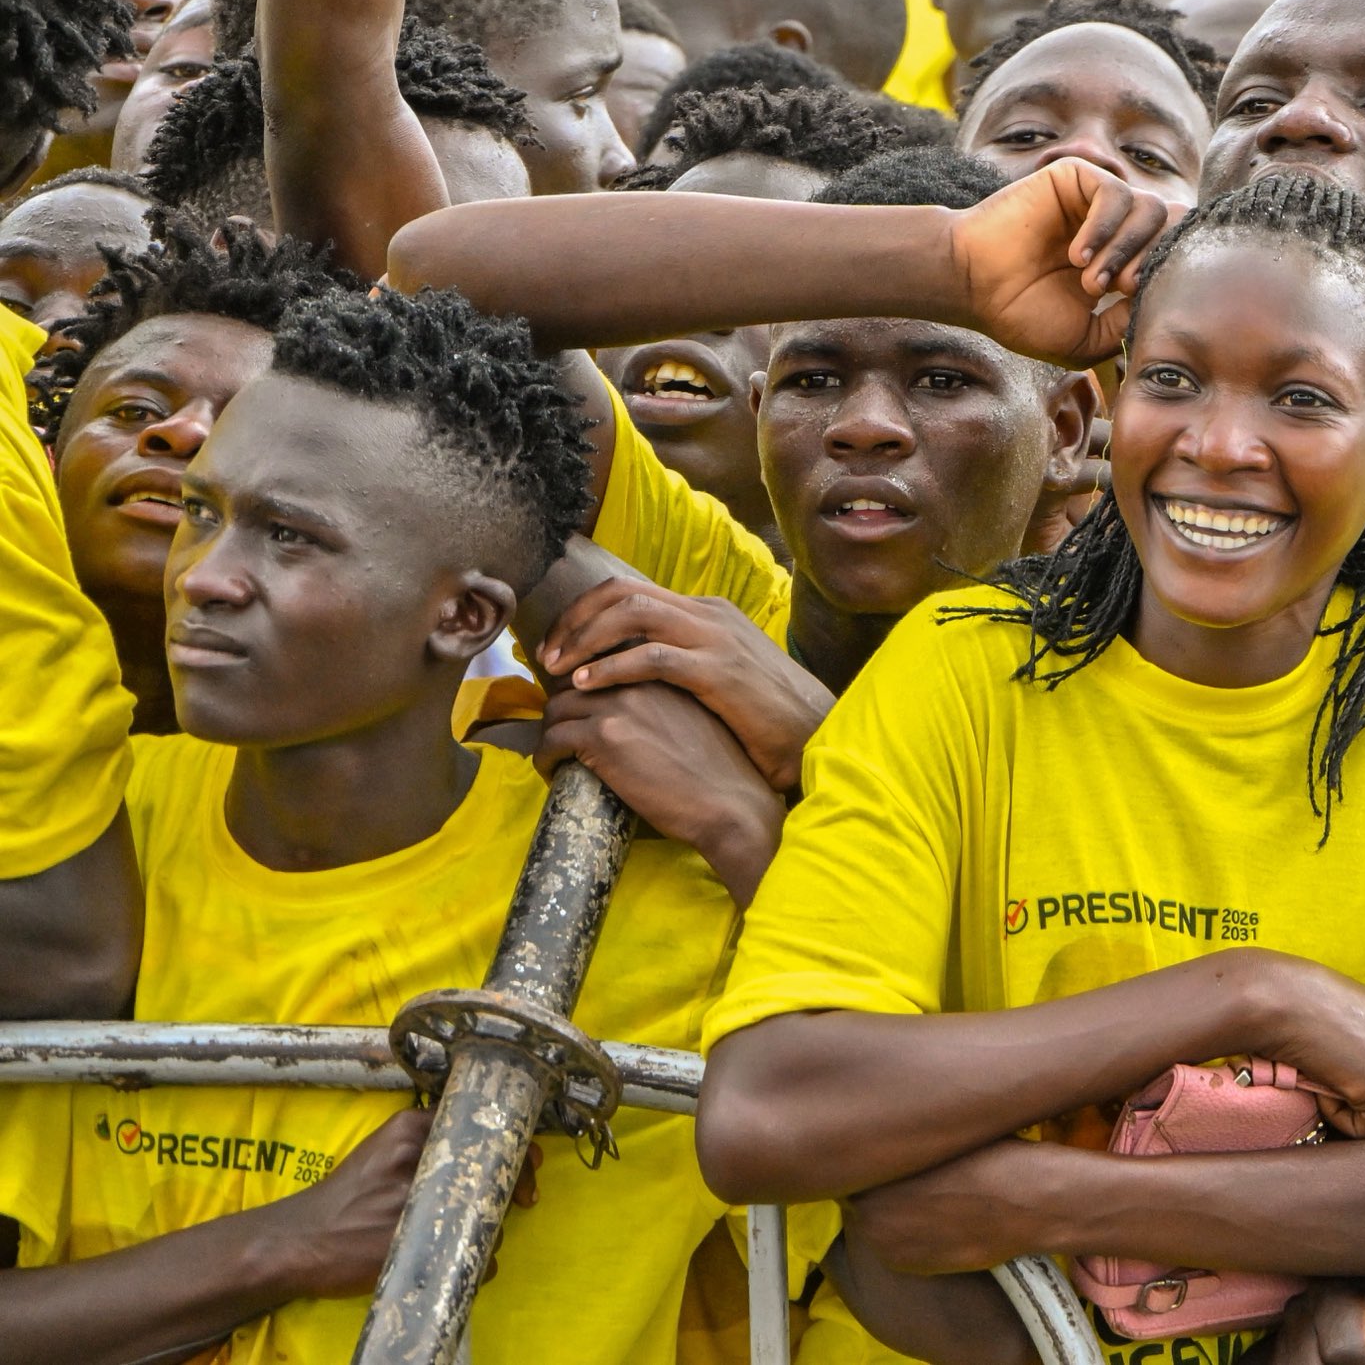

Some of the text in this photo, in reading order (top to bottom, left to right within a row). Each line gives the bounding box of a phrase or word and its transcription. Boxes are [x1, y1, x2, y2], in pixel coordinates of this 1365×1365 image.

[1038, 891, 1259, 940] PRESIDENT 2026
[1221, 925, 1258, 941] 2031
[297, 1149, 335, 1170] 2026
